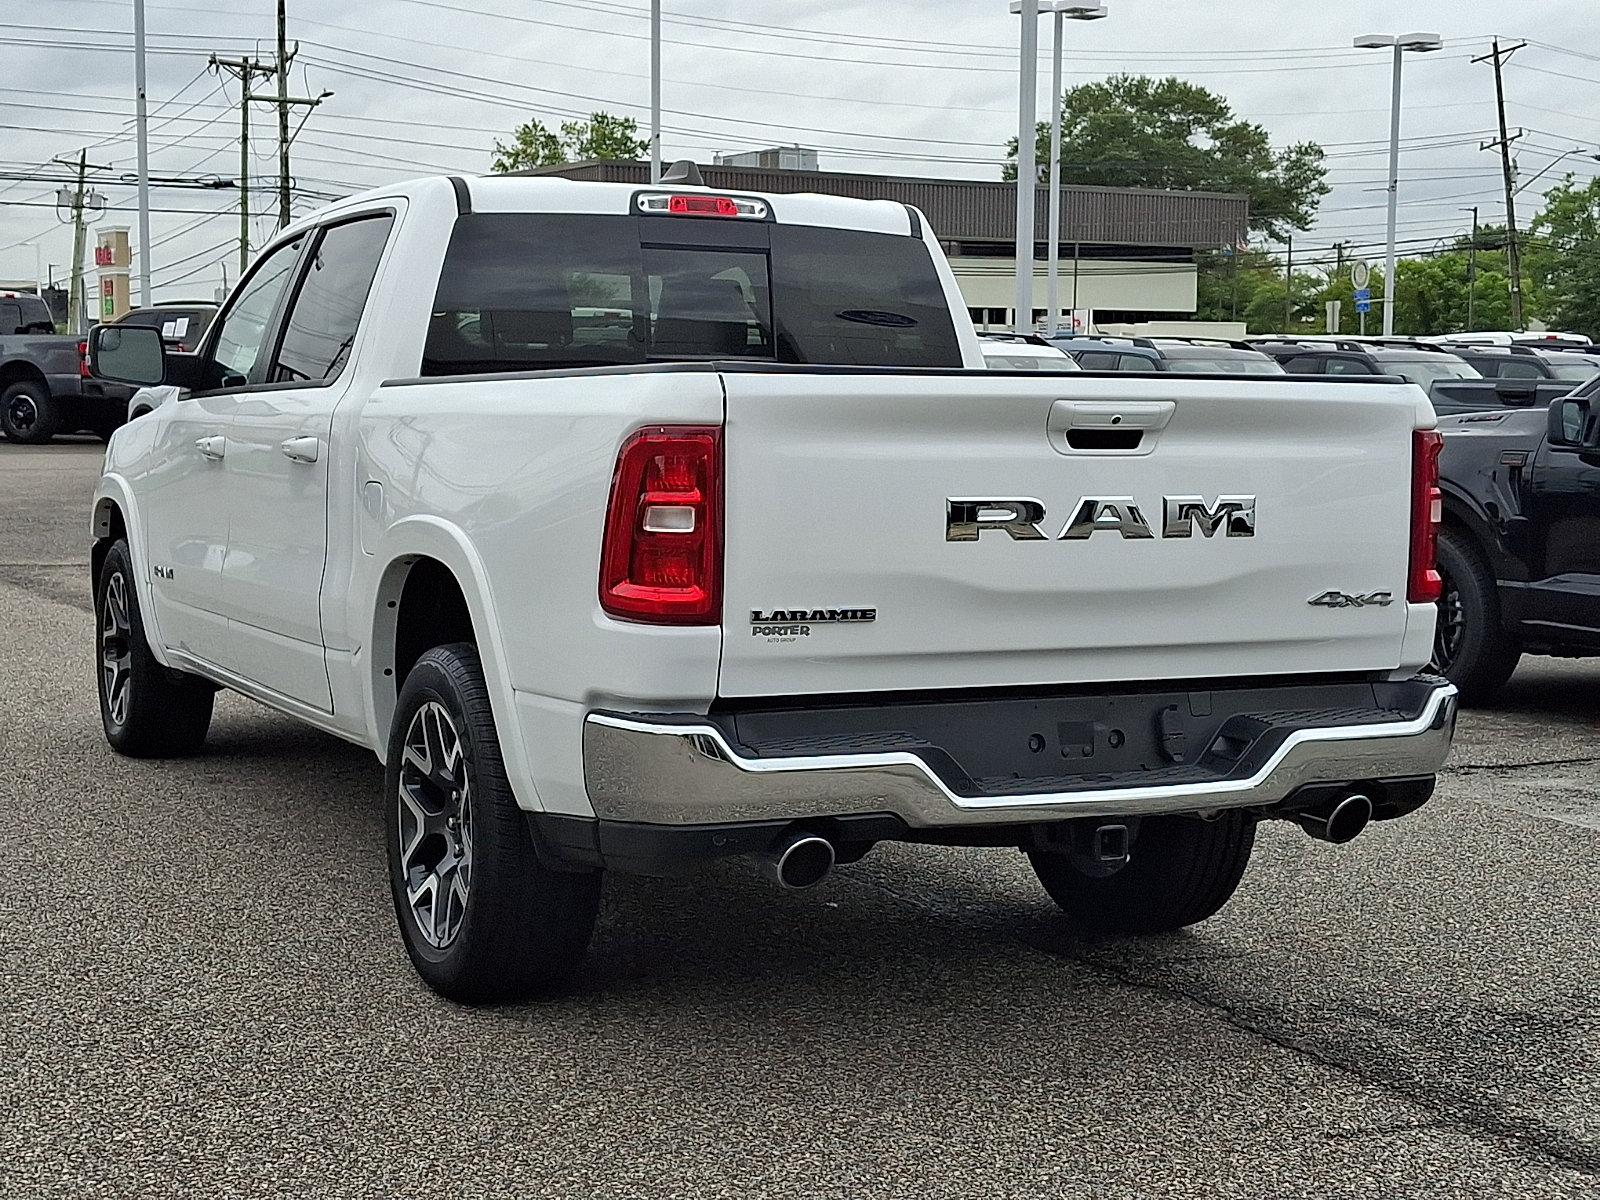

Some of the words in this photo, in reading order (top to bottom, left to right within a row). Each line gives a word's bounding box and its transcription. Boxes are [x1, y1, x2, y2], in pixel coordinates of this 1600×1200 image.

[946, 495, 1256, 541] RAM
[751, 608, 877, 623] LARAMIE
[752, 625, 811, 636] PORTER
